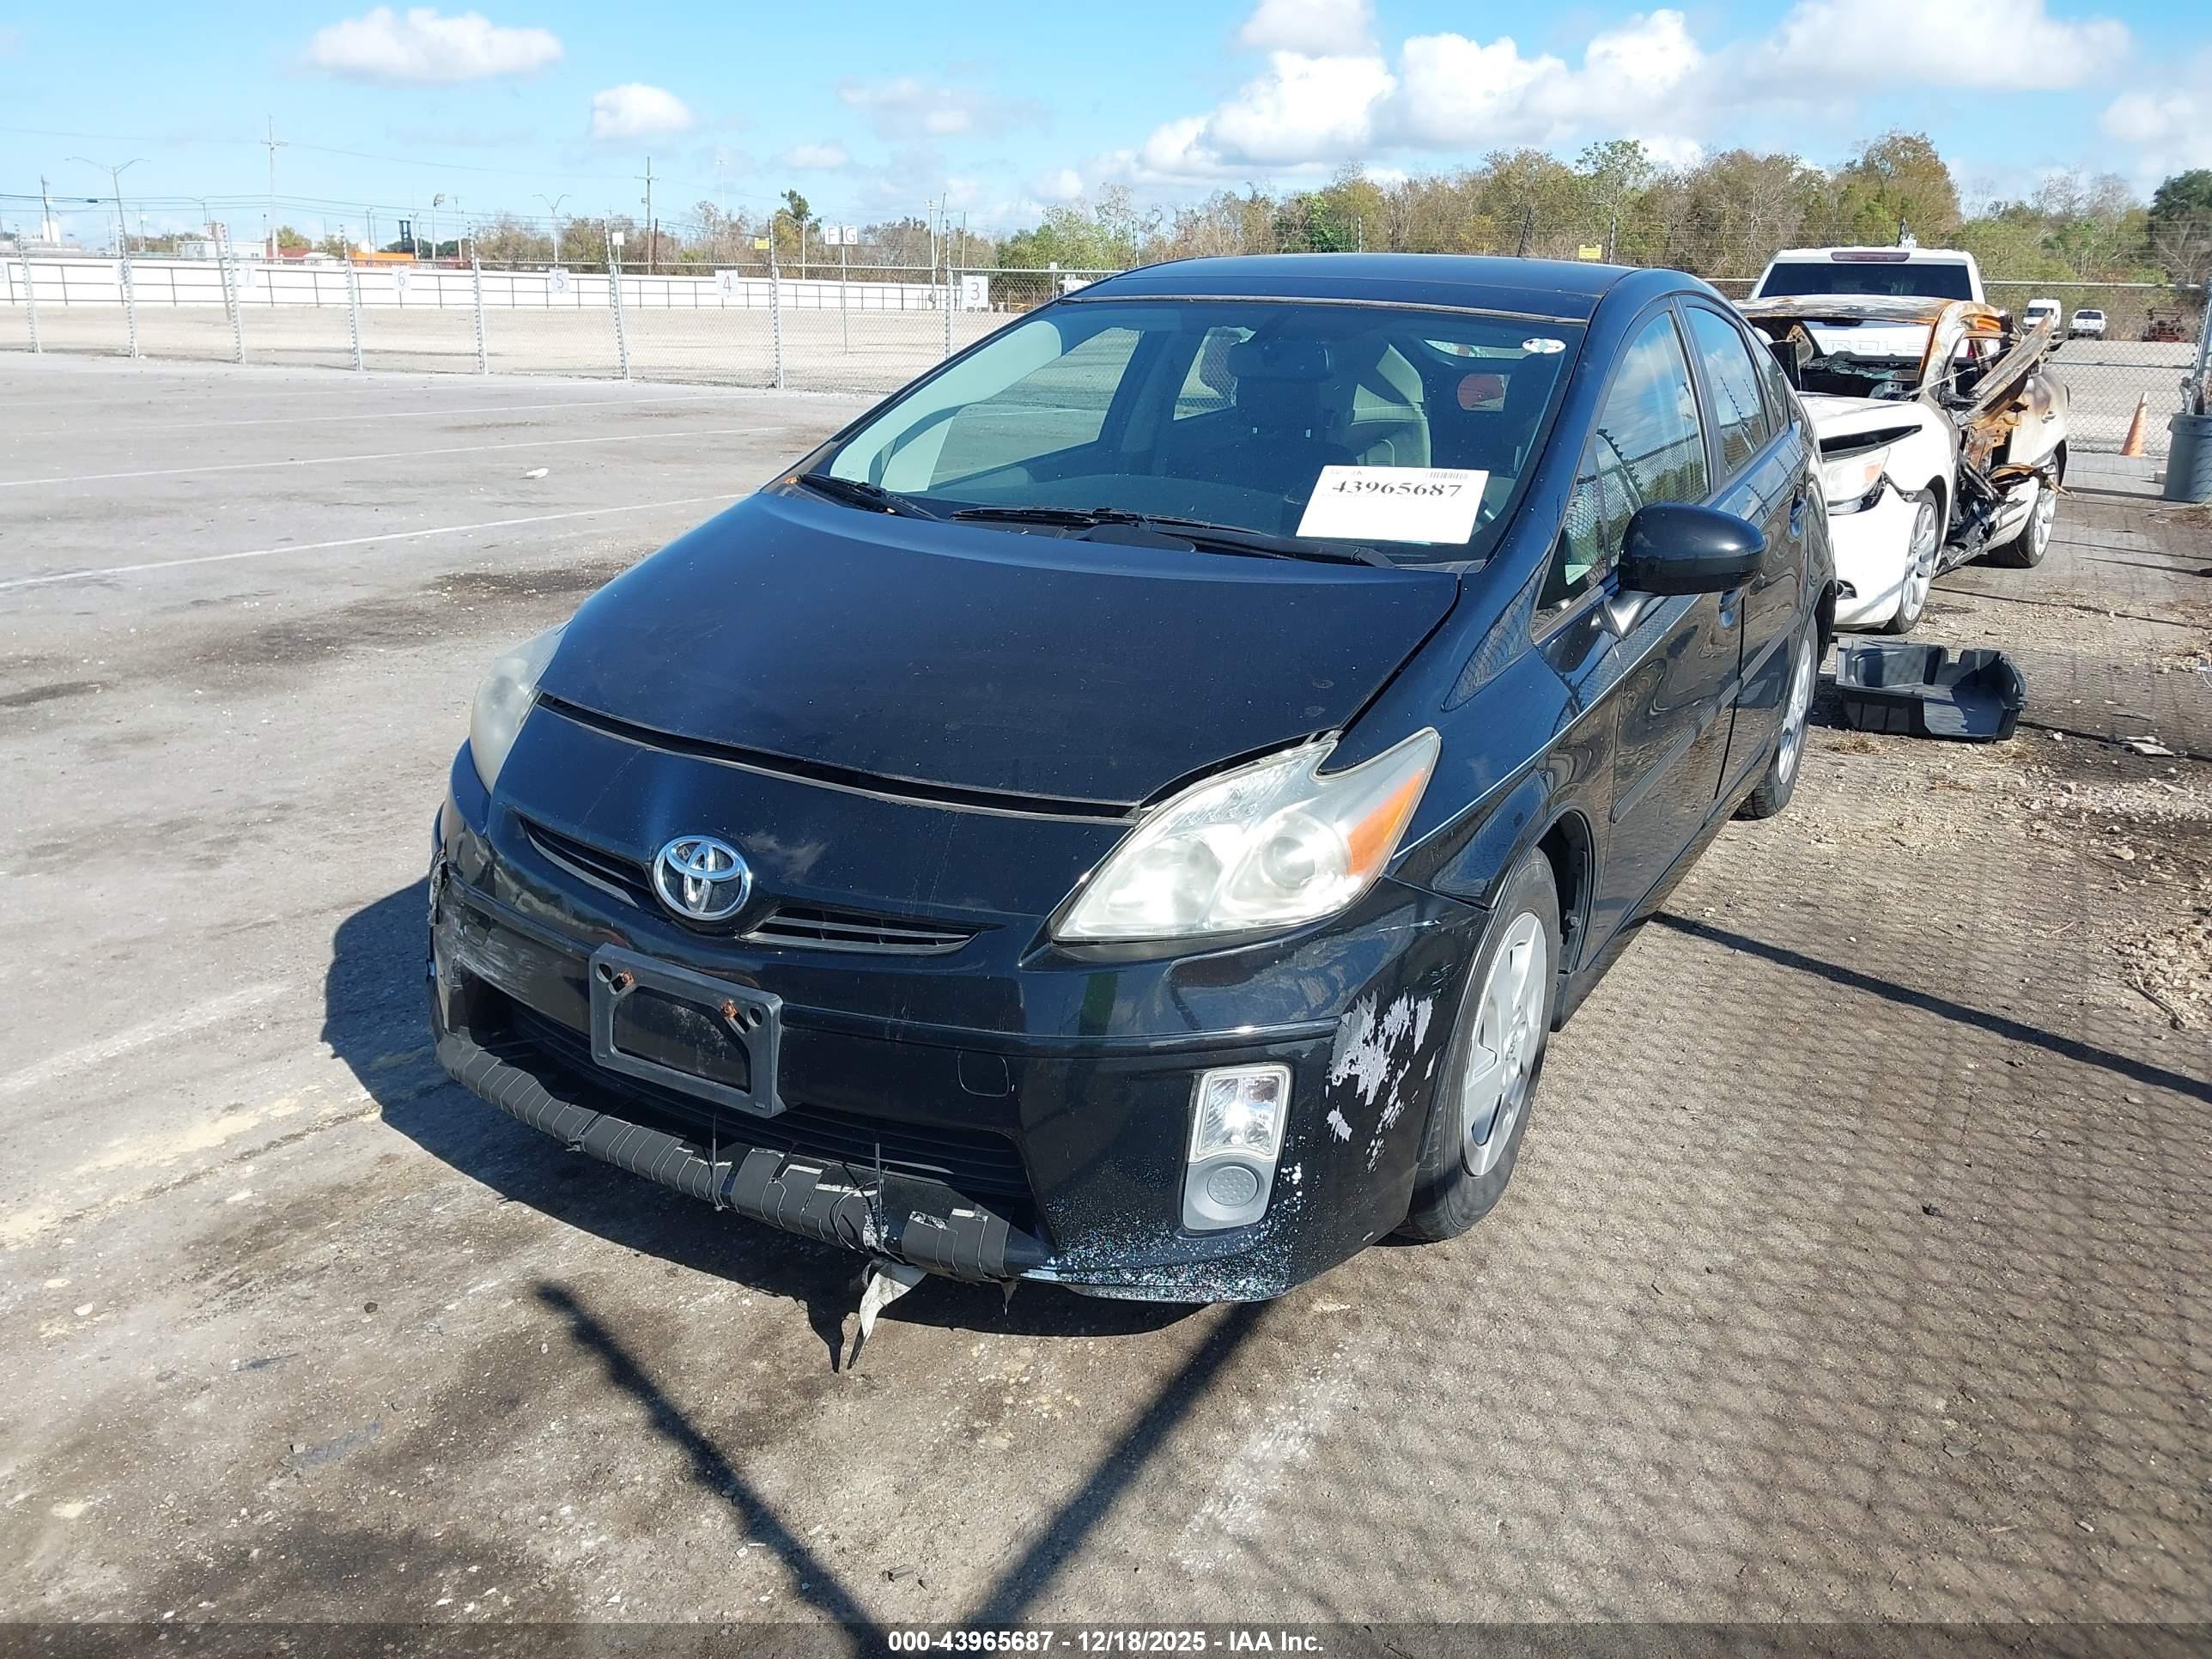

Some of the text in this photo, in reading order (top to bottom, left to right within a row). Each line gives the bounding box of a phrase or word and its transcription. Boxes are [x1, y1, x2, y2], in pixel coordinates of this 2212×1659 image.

[828, 227, 836, 243] F
[845, 227, 856, 243] G
[398, 270, 406, 286] 6
[556, 272, 564, 289] 5
[722, 276, 732, 293] 4
[970, 282, 981, 301] 3
[1332, 480, 1463, 498] 43965687
